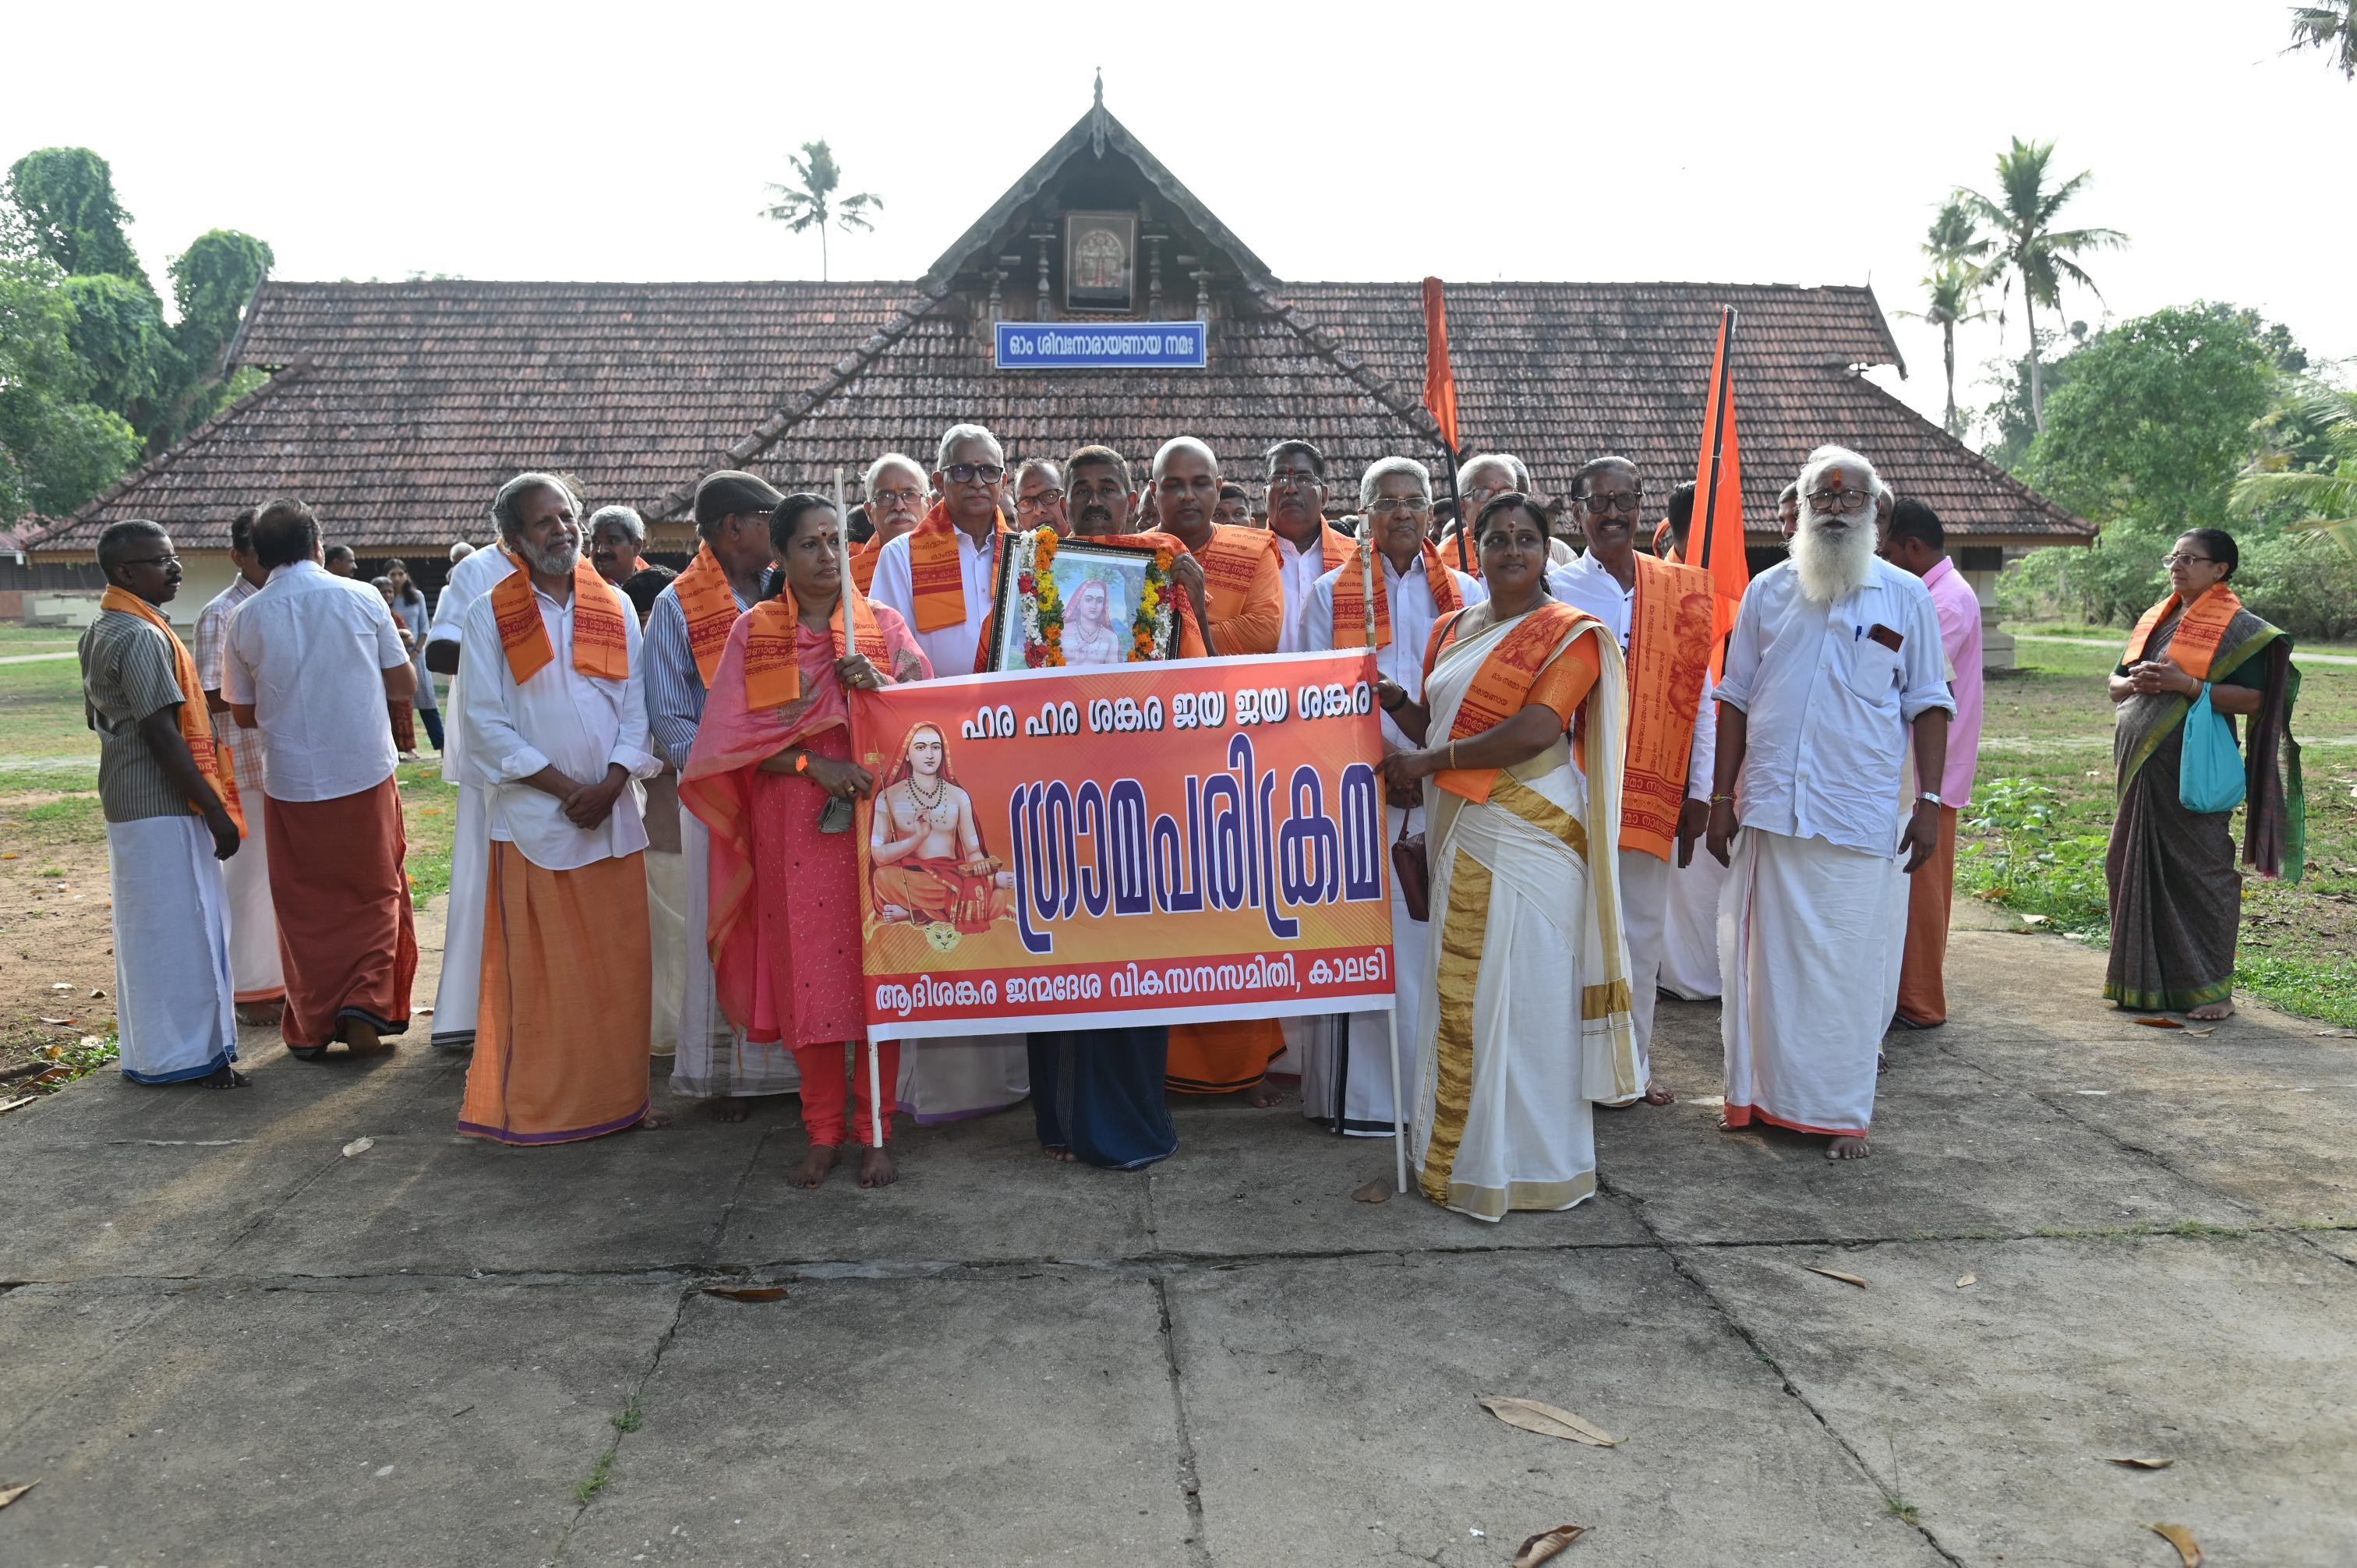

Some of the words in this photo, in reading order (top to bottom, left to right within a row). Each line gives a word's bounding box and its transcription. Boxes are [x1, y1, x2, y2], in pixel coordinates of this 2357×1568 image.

[1009, 335, 1034, 355] ഓം
[1165, 335, 1194, 355] നമഃ
[961, 705, 1016, 739] ഹര
[1025, 701, 1080, 735] ഹര
[1088, 696, 1163, 733] ശങ്കര
[1172, 691, 1226, 729] ജയ
[1235, 687, 1288, 726] ജയ
[1298, 681, 1371, 719] ശങ്കര
[1009, 733, 1383, 954] ഗ്രാമപരിക്രമ
[876, 974, 997, 1016] ആദിശങ്കര
[1005, 973, 1101, 1003] ജന്മദേശ
[1110, 952, 1301, 998] വികസനസമിതി,
[1308, 948, 1387, 984] കാലടി
